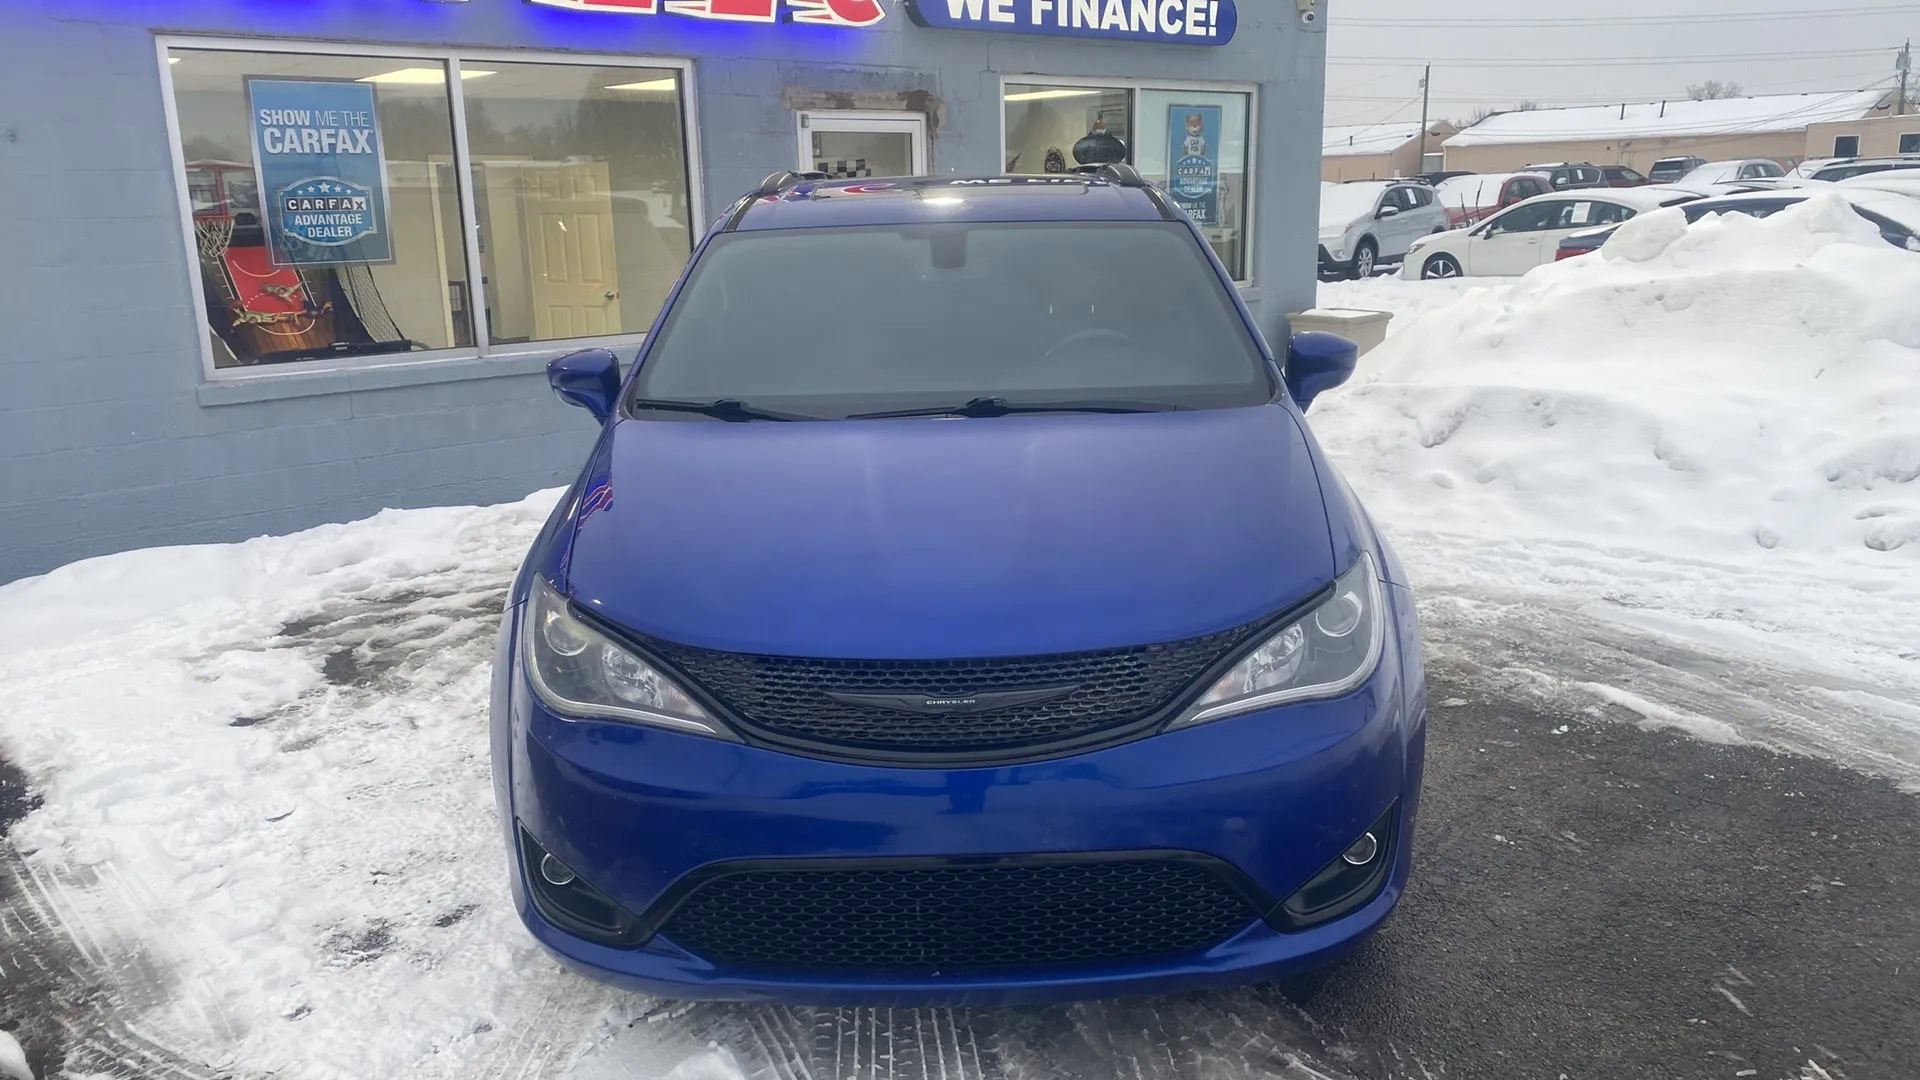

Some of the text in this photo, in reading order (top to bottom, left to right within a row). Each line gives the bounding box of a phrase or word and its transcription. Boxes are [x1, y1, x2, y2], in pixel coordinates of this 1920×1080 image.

[1031, 0, 1219, 36] FINANCE!
[260, 109, 369, 127] SHOW ME THE
[263, 127, 373, 154] CARFAX
[288, 199, 364, 211] CARFAX
[294, 213, 363, 226] ADVANTAGE
[1186, 209, 1207, 219] RFAX
[307, 226, 353, 239] DEALER
